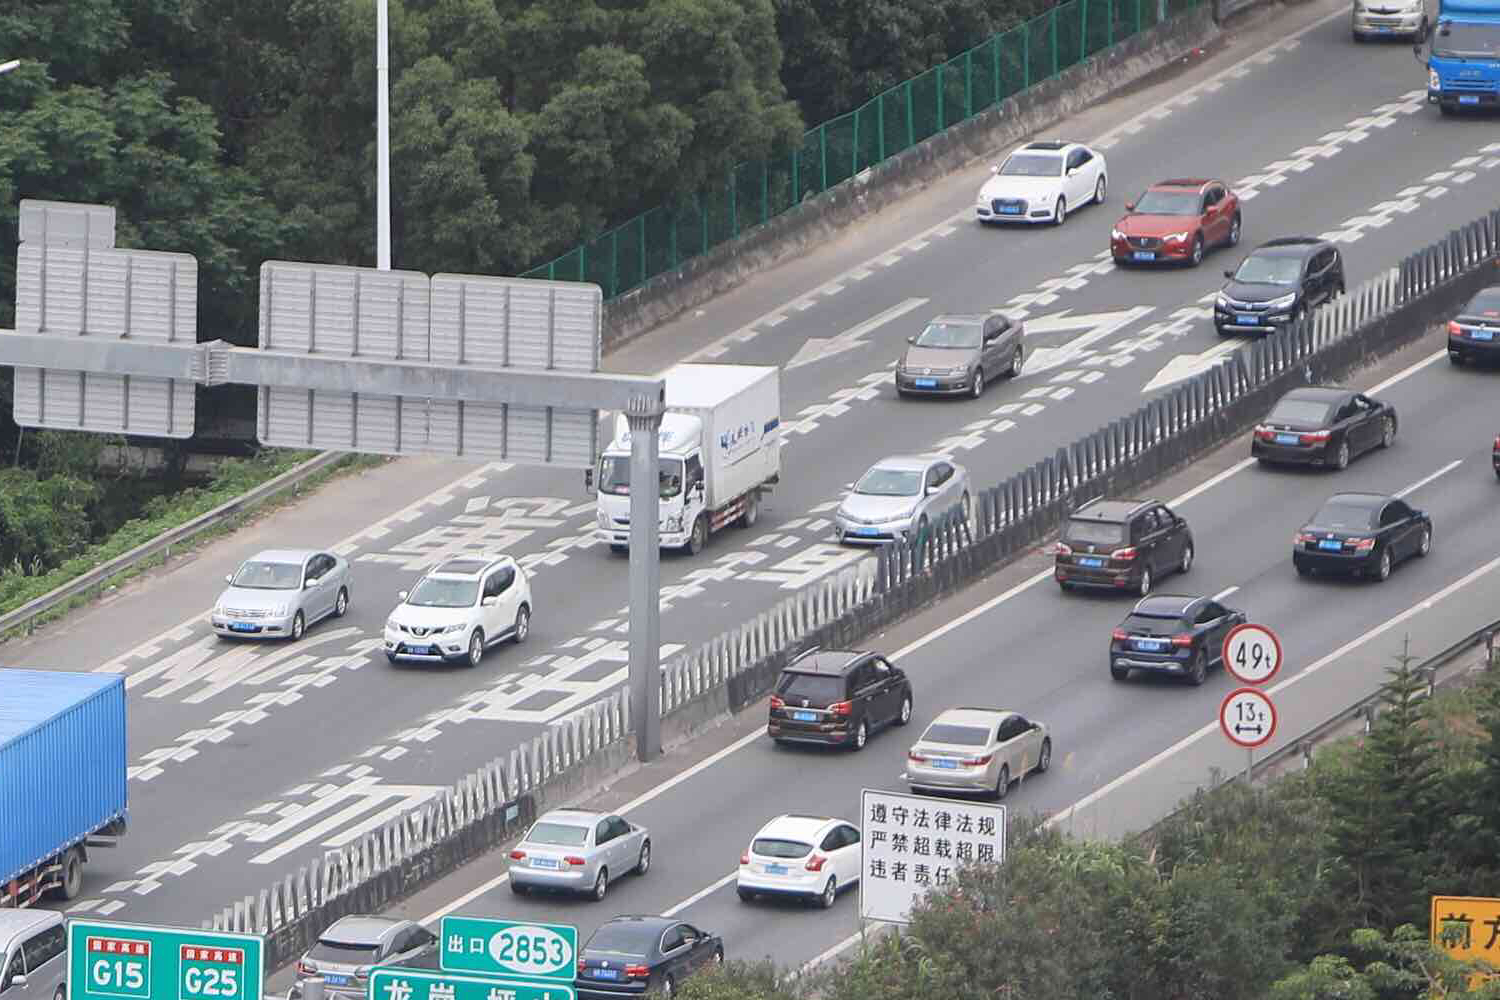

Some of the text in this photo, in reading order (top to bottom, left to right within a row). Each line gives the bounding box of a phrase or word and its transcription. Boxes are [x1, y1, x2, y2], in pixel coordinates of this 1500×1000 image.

[1236, 641, 1270, 669] 49t
[1236, 702, 1264, 722] 13t
[870, 803, 995, 837] 遵守法律法规
[870, 830, 996, 864] 严禁超载超限
[447, 932, 565, 967] 出口 2853
[92, 959, 238, 997] G15 G25
